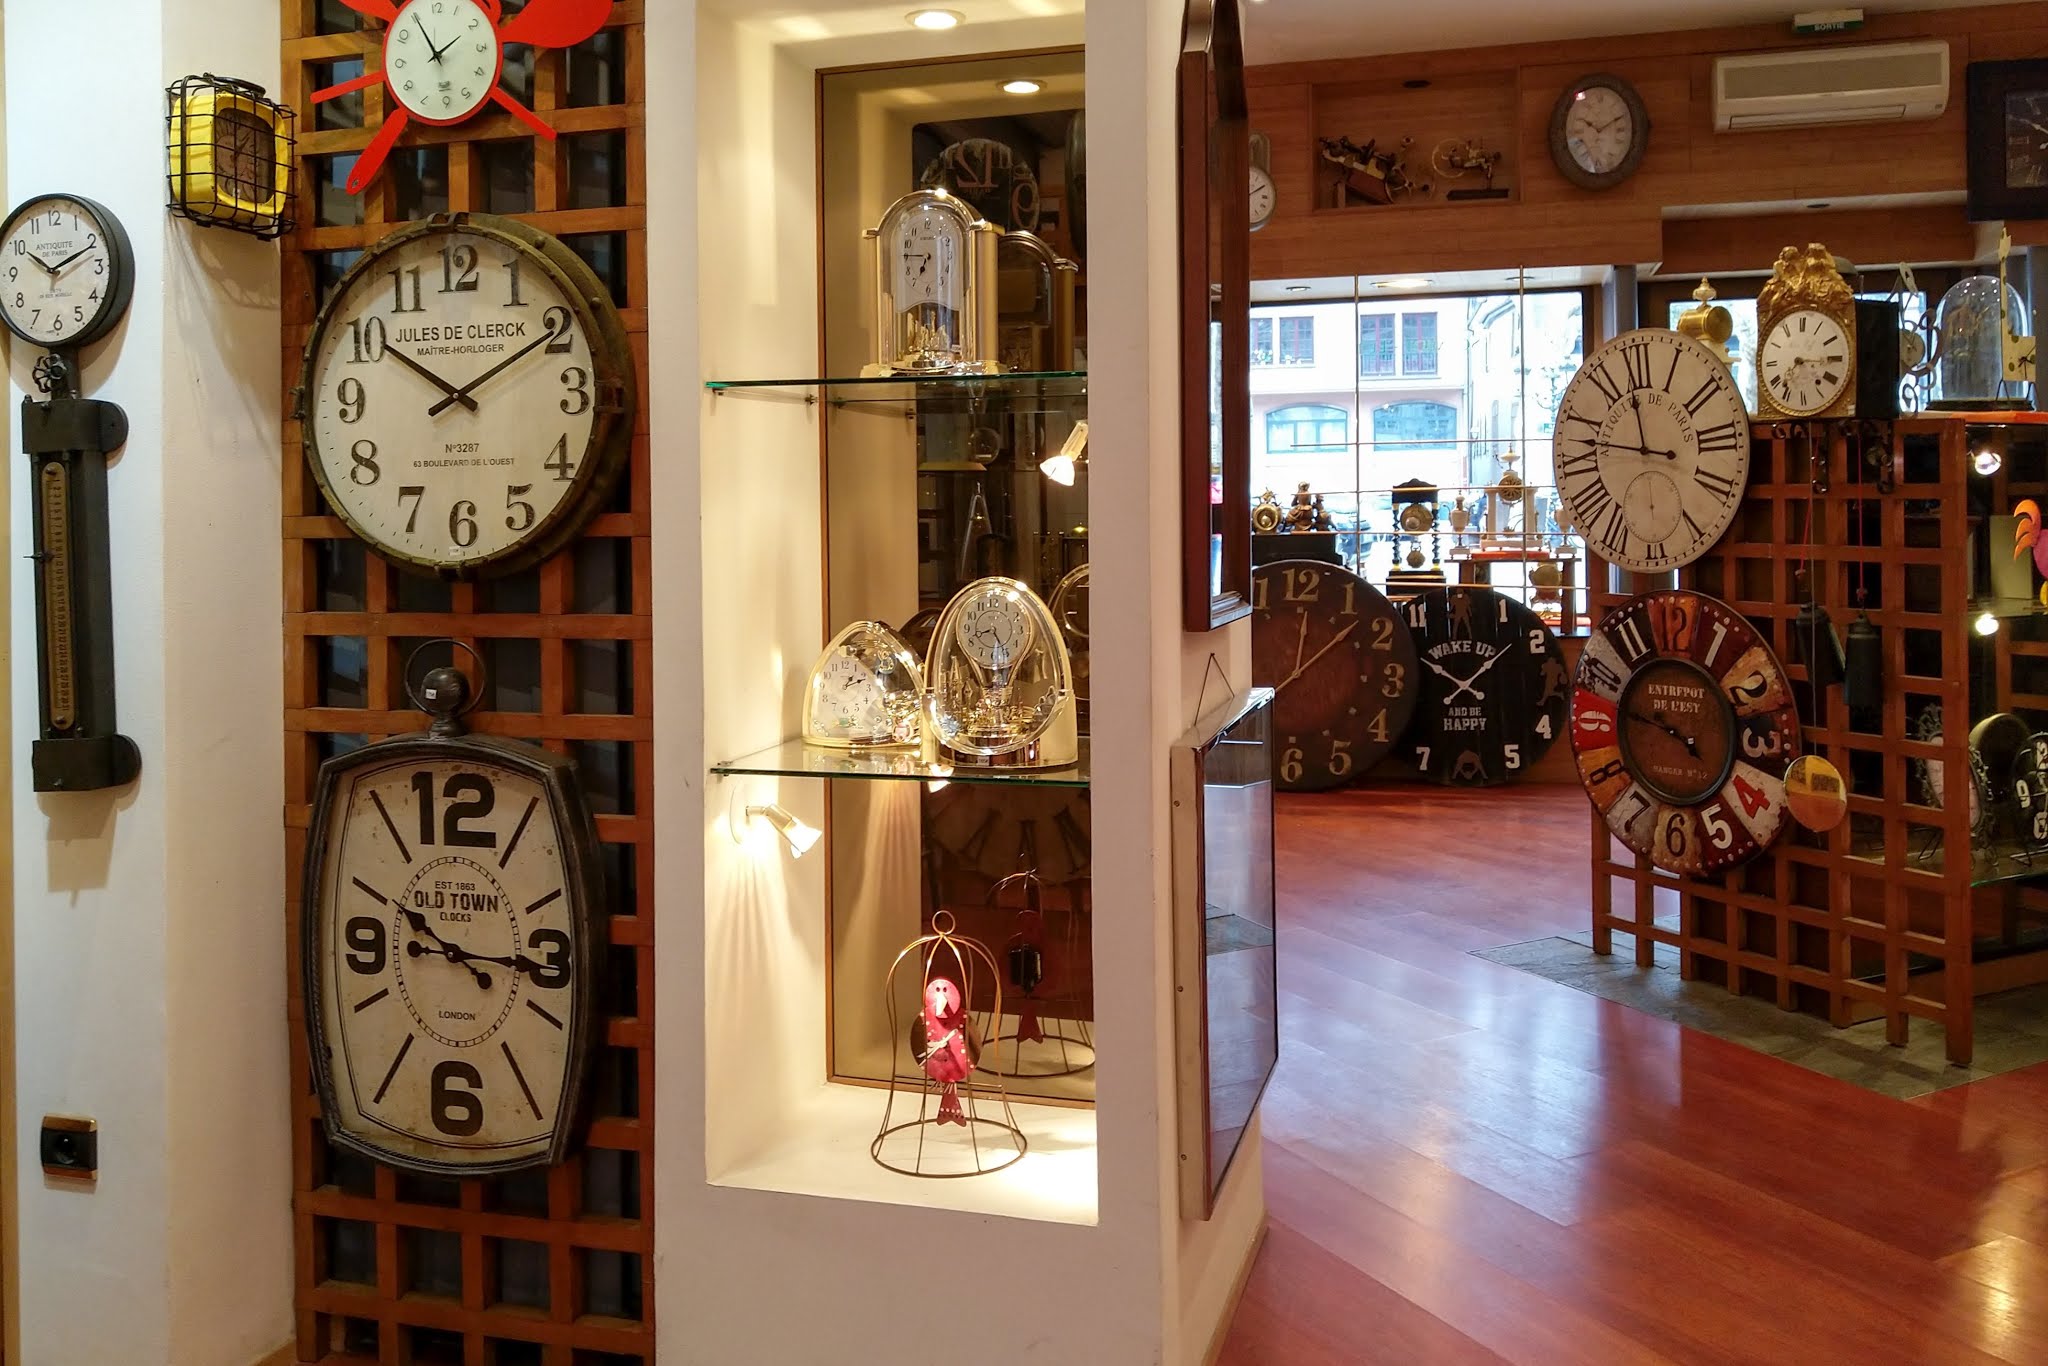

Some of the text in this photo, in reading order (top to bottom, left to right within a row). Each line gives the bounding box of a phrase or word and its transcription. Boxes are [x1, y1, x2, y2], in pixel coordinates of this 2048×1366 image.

[432, 2, 442, 14] 12
[453, 5, 459, 16] 1
[468, 18, 479, 30] 2
[1814, 22, 1845, 31] SORTIE
[397, 29, 409, 44] 10
[476, 43, 487, 53] 3
[473, 66, 485, 77] 4
[403, 80, 413, 91] 8
[461, 87, 471, 99] 5
[420, 95, 429, 105] 7
[31, 218, 39, 235] 11
[48, 210, 61, 226] 12
[74, 215, 78, 231] 1
[14, 240, 26, 256] 10
[36, 241, 73, 251] ANTIQUITE
[87, 233, 97, 249] 2
[9, 266, 18, 282] 9
[94, 259, 104, 275] 3
[437, 244, 480, 293] 12
[88, 287, 99, 303] 4
[388, 264, 426, 314] 11
[502, 258, 528, 308] 1
[16, 292, 25, 308] 8
[31, 309, 42, 325] 7
[53, 314, 63, 331] 6
[74, 306, 84, 322] 5
[346, 315, 387, 364] 10
[395, 322, 526, 342] JULES DE CLERCK
[542, 305, 574, 355] 2
[417, 343, 505, 356] MAÎTRE-HORLOGER
[1620, 343, 1653, 394] XII
[1662, 348, 1683, 394] I
[559, 366, 590, 415] 3
[1583, 361, 1623, 411] XI
[1683, 375, 1723, 418] II
[337, 377, 366, 424] 9
[1648, 392, 1663, 407] DE
[1668, 401, 1694, 444] PARIS
[350, 439, 381, 486] 8
[423, 458, 469, 467] BOULEVARD
[471, 458, 481, 466] DE
[483, 457, 515, 466] L'OUEST
[543, 433, 576, 481] 4
[397, 485, 425, 534] 7
[504, 483, 535, 531] 5
[449, 500, 478, 547] 6
[1282, 568, 1320, 602] 12
[977, 602, 984, 611] 11
[988, 599, 998, 608] 12
[1005, 603, 1008, 611] 1
[1340, 582, 1358, 615] 1
[967, 611, 976, 620] 10
[1013, 612, 1019, 621] 2
[1408, 604, 1427, 628] 11
[1499, 599, 1508, 623] 1
[964, 624, 970, 633] 9
[1017, 625, 1023, 635] 3
[1372, 617, 1393, 650] 2
[1615, 617, 1650, 663] 11
[1661, 607, 1687, 653] 12
[968, 638, 974, 647] 8
[979, 647, 983, 656] 7
[1428, 640, 1496, 660] WAKE UP
[1529, 629, 1545, 654] 2
[1704, 621, 1727, 668] 1
[1382, 663, 1404, 697] 3
[1583, 655, 1621, 693] 10
[1729, 671, 1768, 706] 2
[1448, 707, 1482, 717] AND BE
[1653, 699, 1668, 710] DE
[1367, 708, 1389, 742] 4
[1443, 718, 1487, 731] HAPPY
[1535, 715, 1552, 740] 4
[1578, 710, 1612, 732] 9
[1742, 727, 1781, 759] 3
[1280, 747, 1303, 782] 6
[1329, 740, 1352, 776] 5
[1416, 746, 1431, 771] 7
[1504, 744, 1521, 769] 5
[1590, 759, 1625, 786] 8
[1733, 774, 1770, 818] 4
[411, 770, 497, 849] 12
[1624, 790, 1650, 833] 7
[1665, 813, 1686, 858] 6
[1701, 802, 1733, 850] 5
[434, 881, 476, 891] EST 1863
[413, 890, 499, 914] OLD TOWN
[439, 911, 472, 923] CLOCKS
[345, 916, 386, 976] 9
[528, 928, 571, 990] 3
[438, 1010, 476, 1022] LONDON
[430, 1059, 484, 1137] 6
